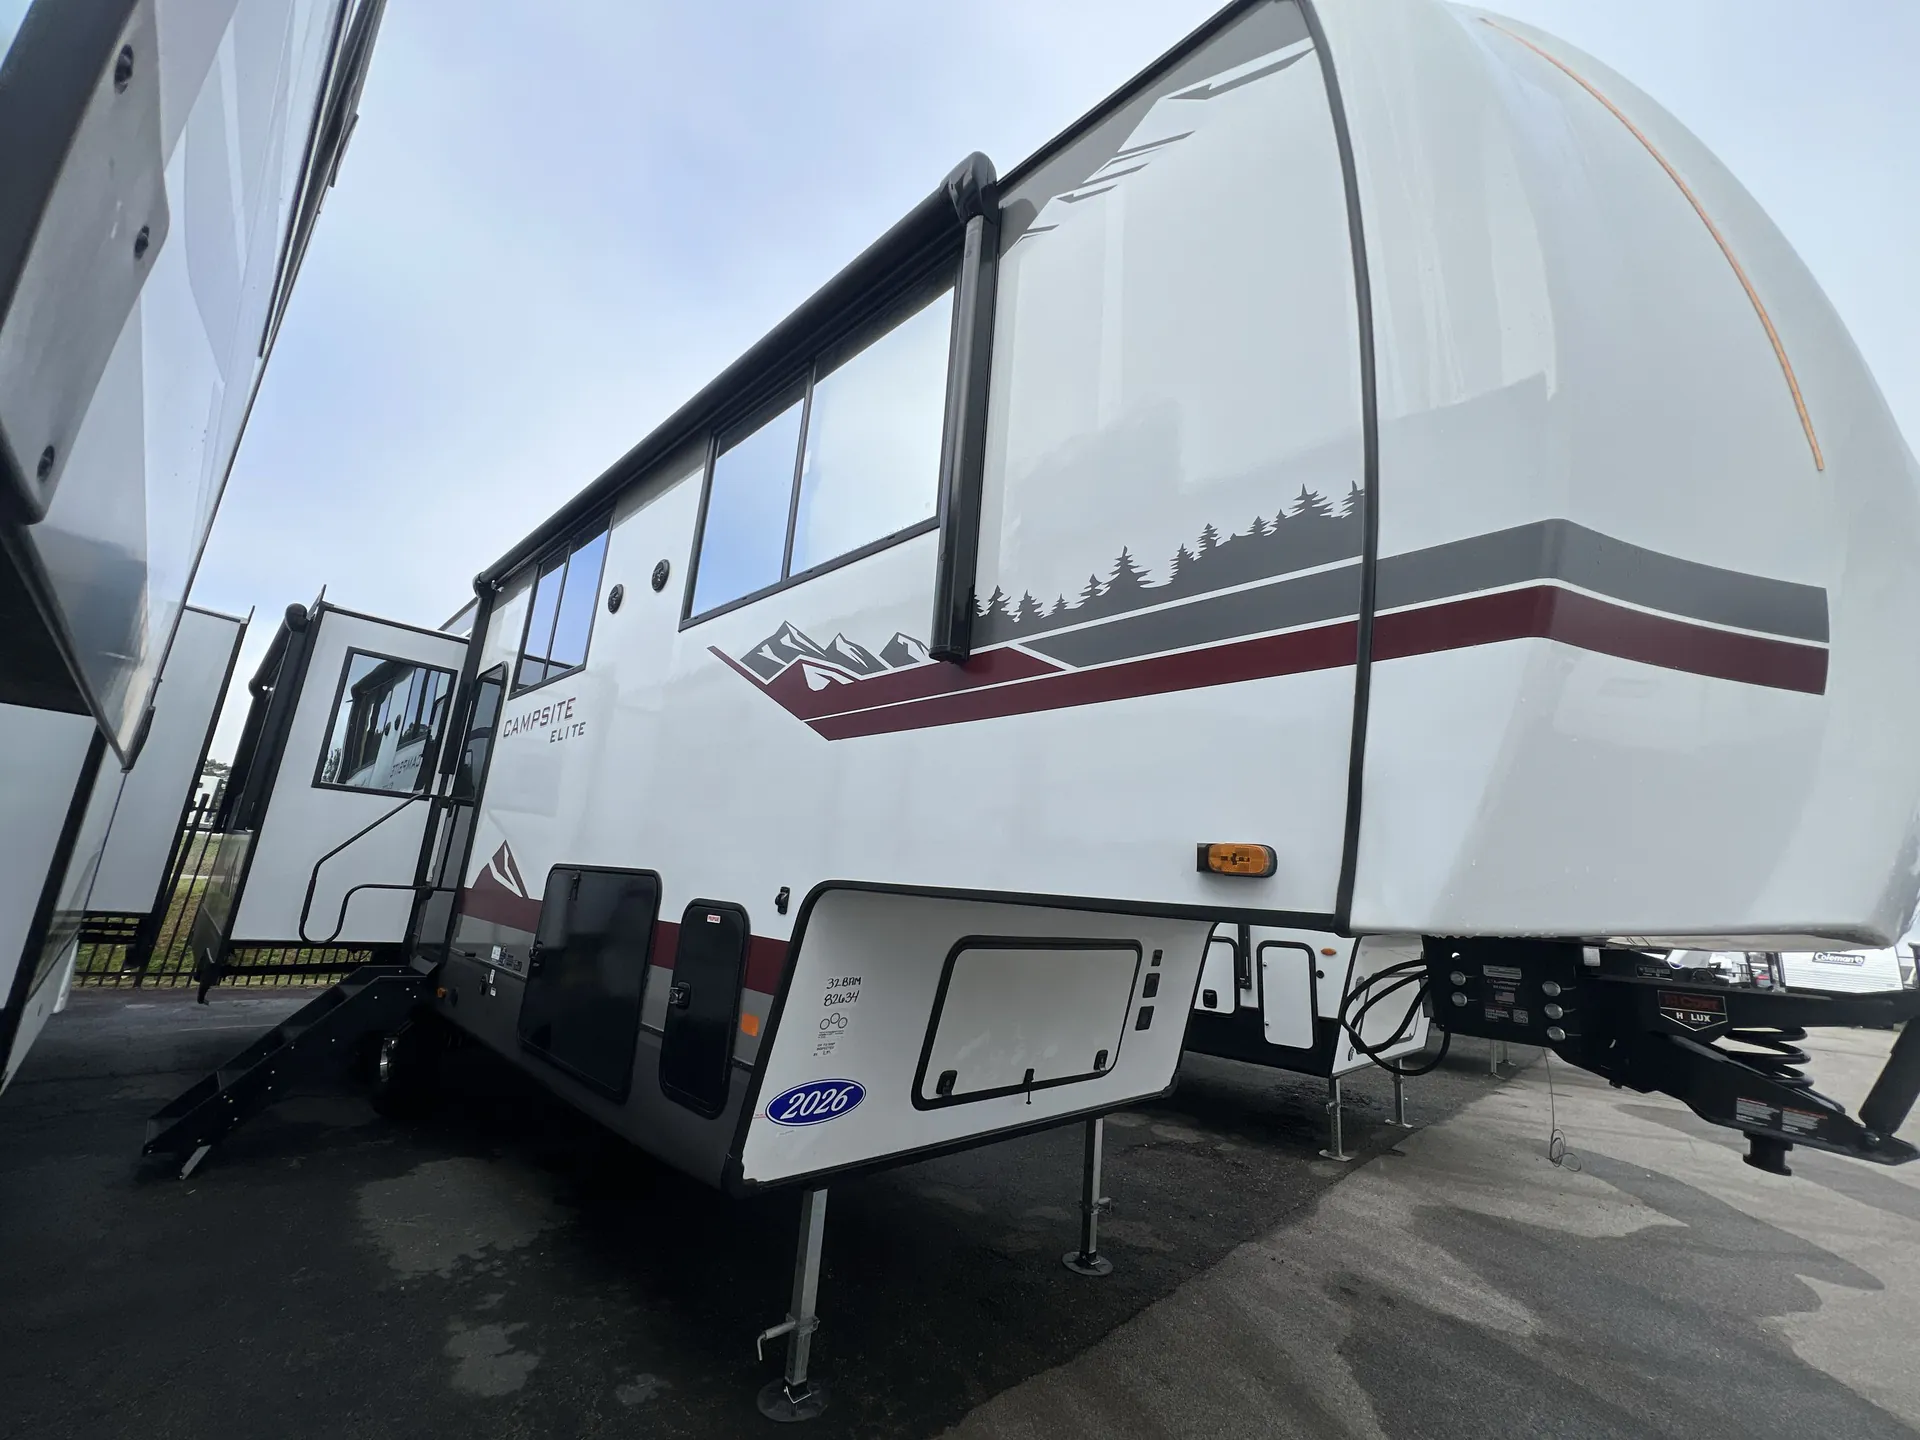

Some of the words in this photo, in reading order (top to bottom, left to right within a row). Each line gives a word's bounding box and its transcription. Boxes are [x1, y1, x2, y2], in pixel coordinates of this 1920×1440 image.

[503, 697, 576, 738] CAMPSITE
[549, 721, 586, 743] ELITE
[1814, 951, 1855, 963] Coleman
[823, 990, 860, 1007] 82634
[780, 1085, 855, 1120] 2026
